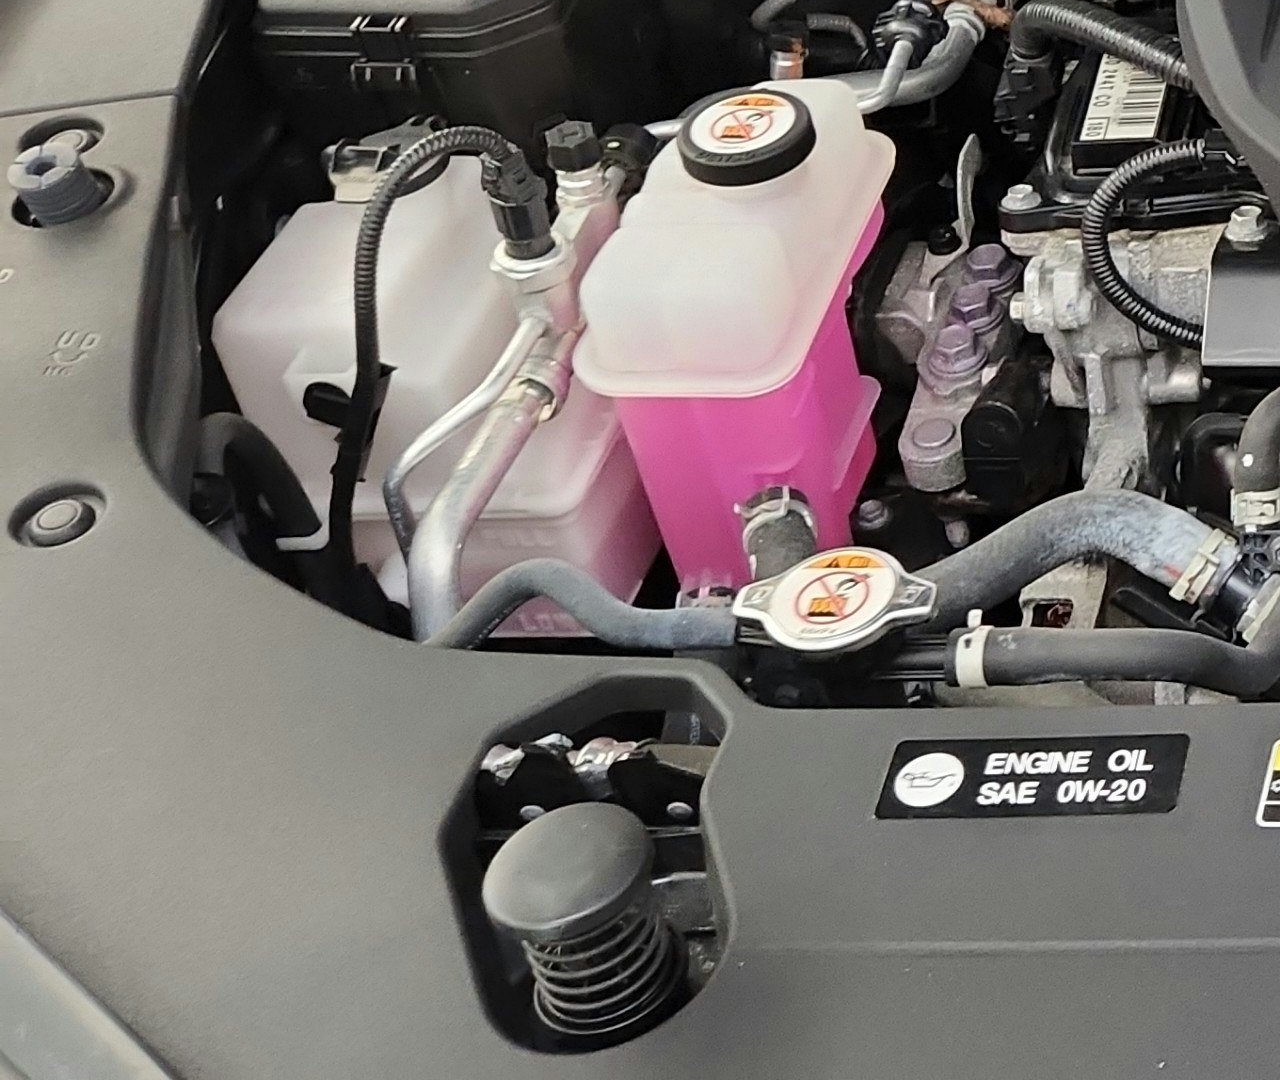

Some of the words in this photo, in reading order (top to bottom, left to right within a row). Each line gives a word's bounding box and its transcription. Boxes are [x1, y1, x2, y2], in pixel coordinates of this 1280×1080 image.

[984, 751, 1092, 775] ENGINE
[1107, 749, 1154, 772] OIL
[977, 781, 1040, 805] SAE
[1057, 778, 1146, 802] 0W-20
